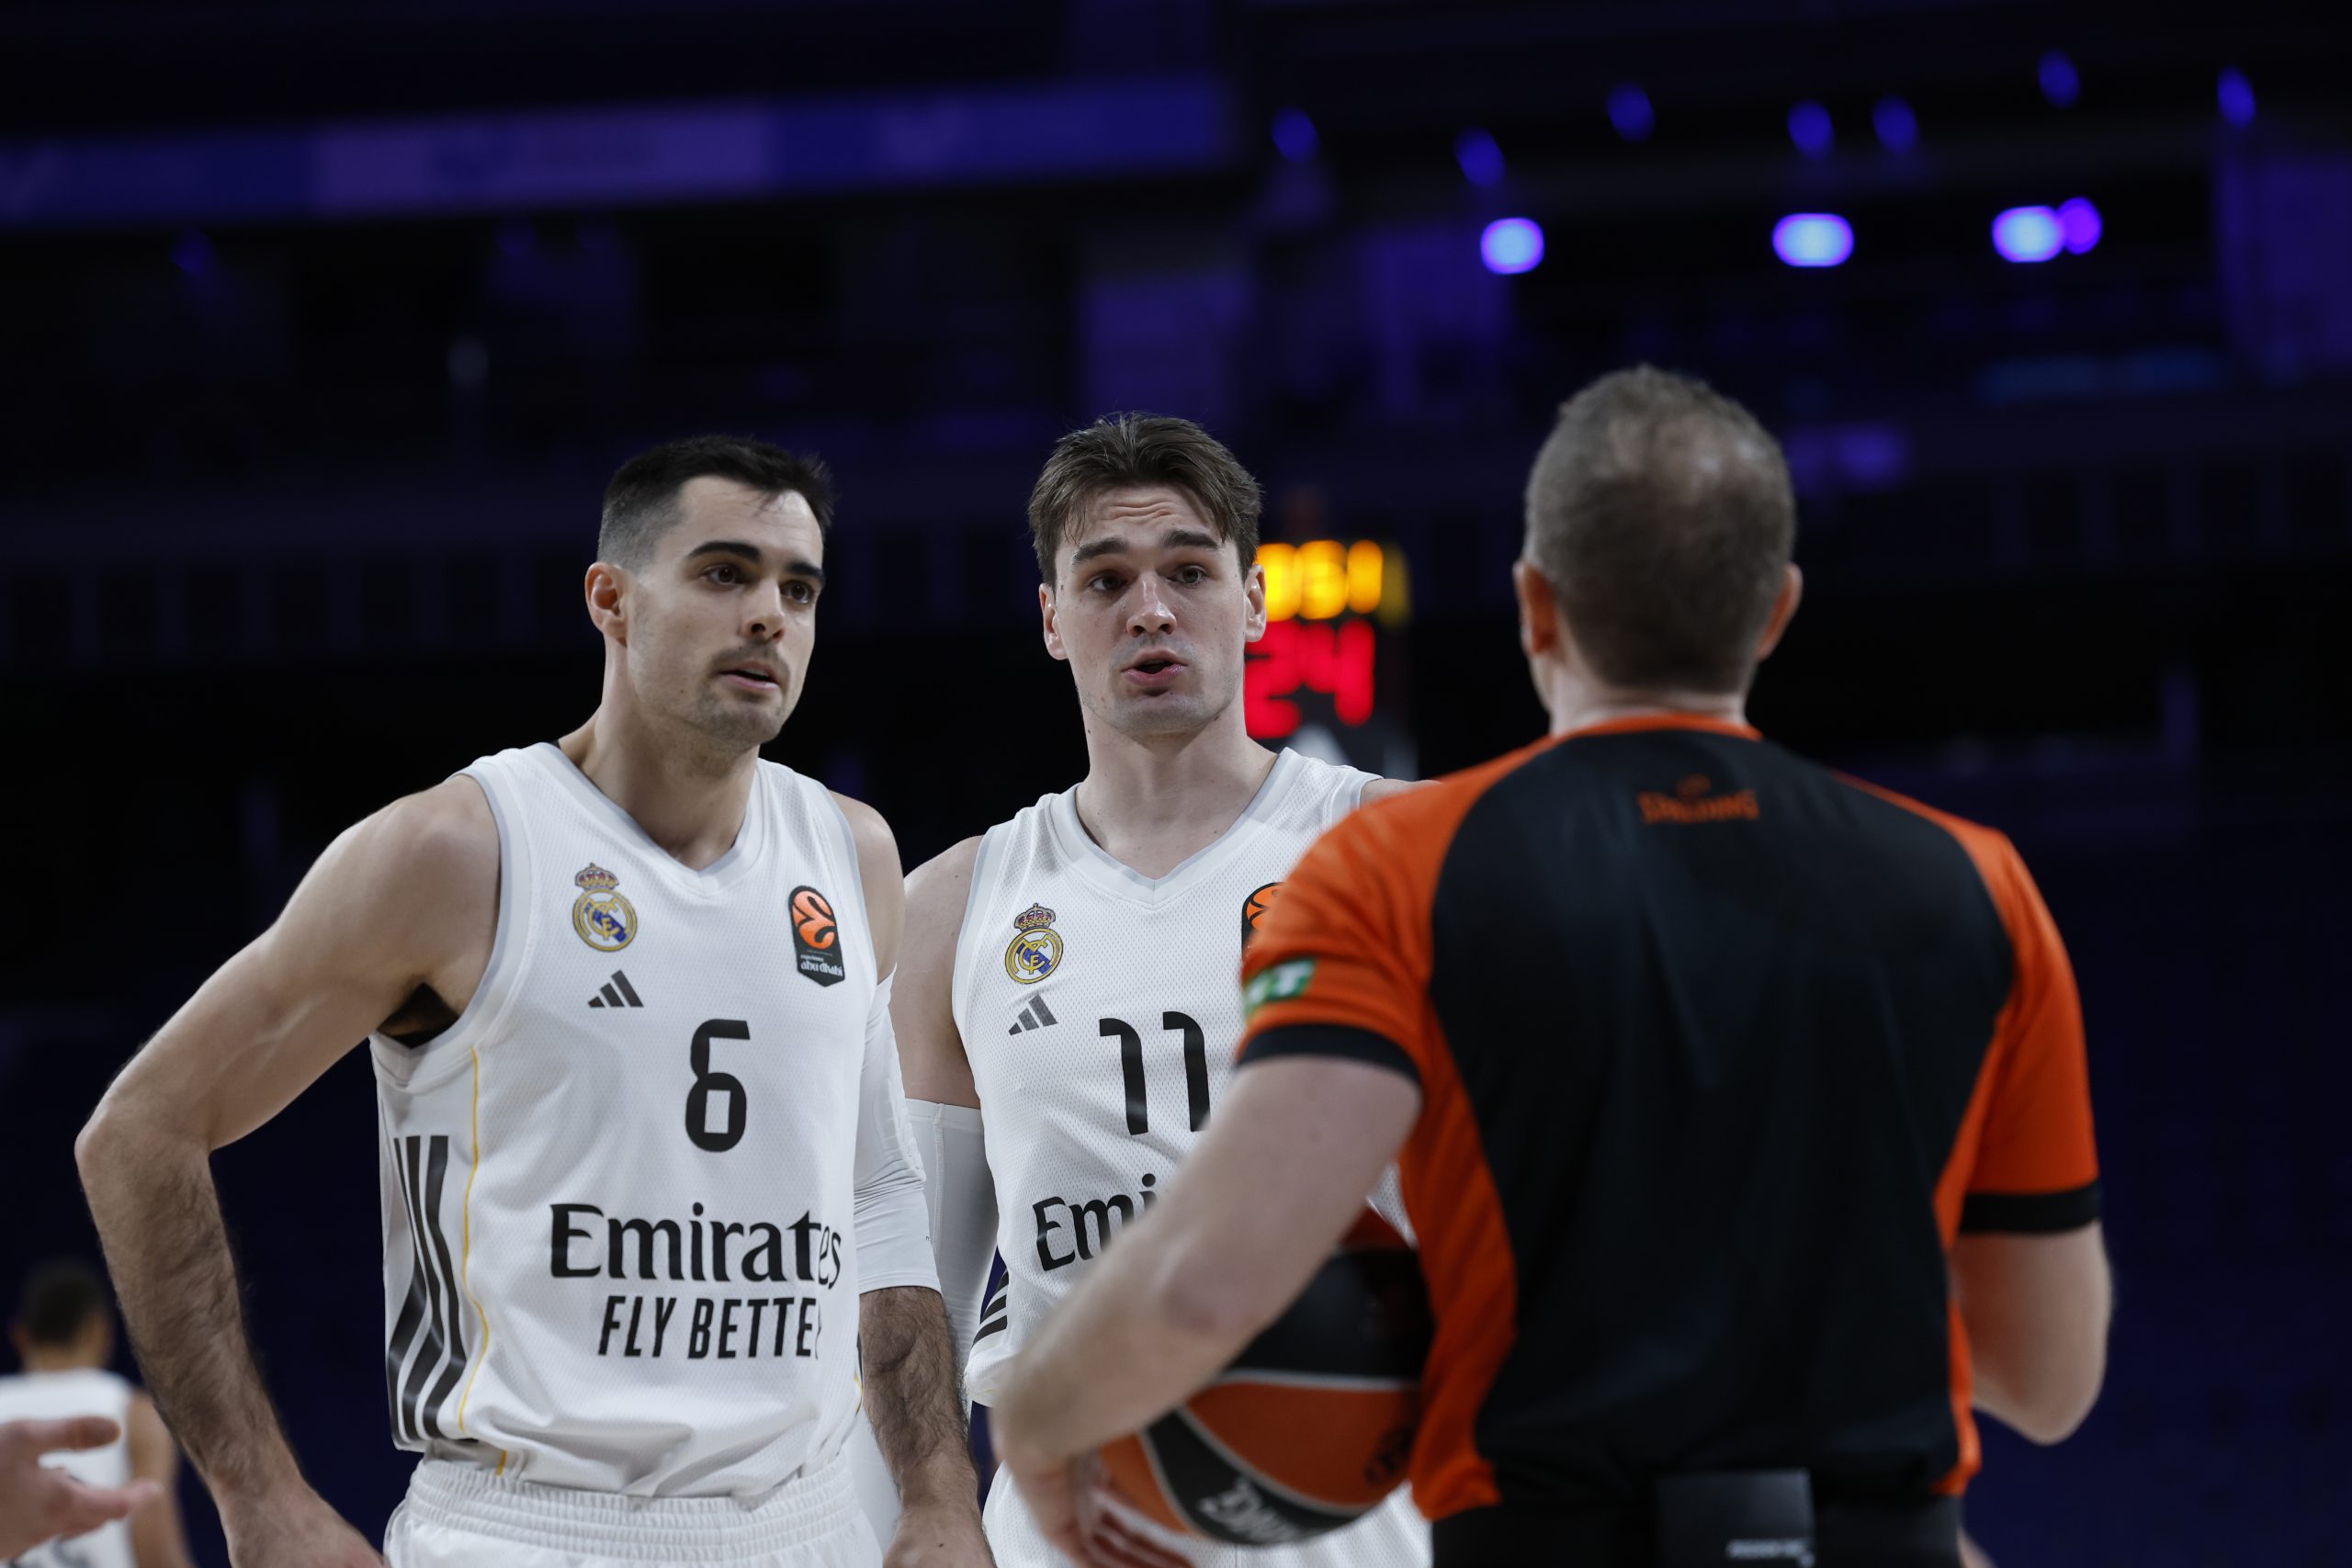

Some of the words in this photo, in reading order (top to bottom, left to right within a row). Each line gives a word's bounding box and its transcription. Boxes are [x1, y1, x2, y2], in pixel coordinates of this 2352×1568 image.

[1244, 619, 1374, 739] 24
[685, 1019, 751, 1153] 6
[1099, 1011, 1210, 1135] 11
[549, 1201, 842, 1290] Emirates
[597, 1295, 677, 1358] FLY
[687, 1297, 821, 1359] BETTE
